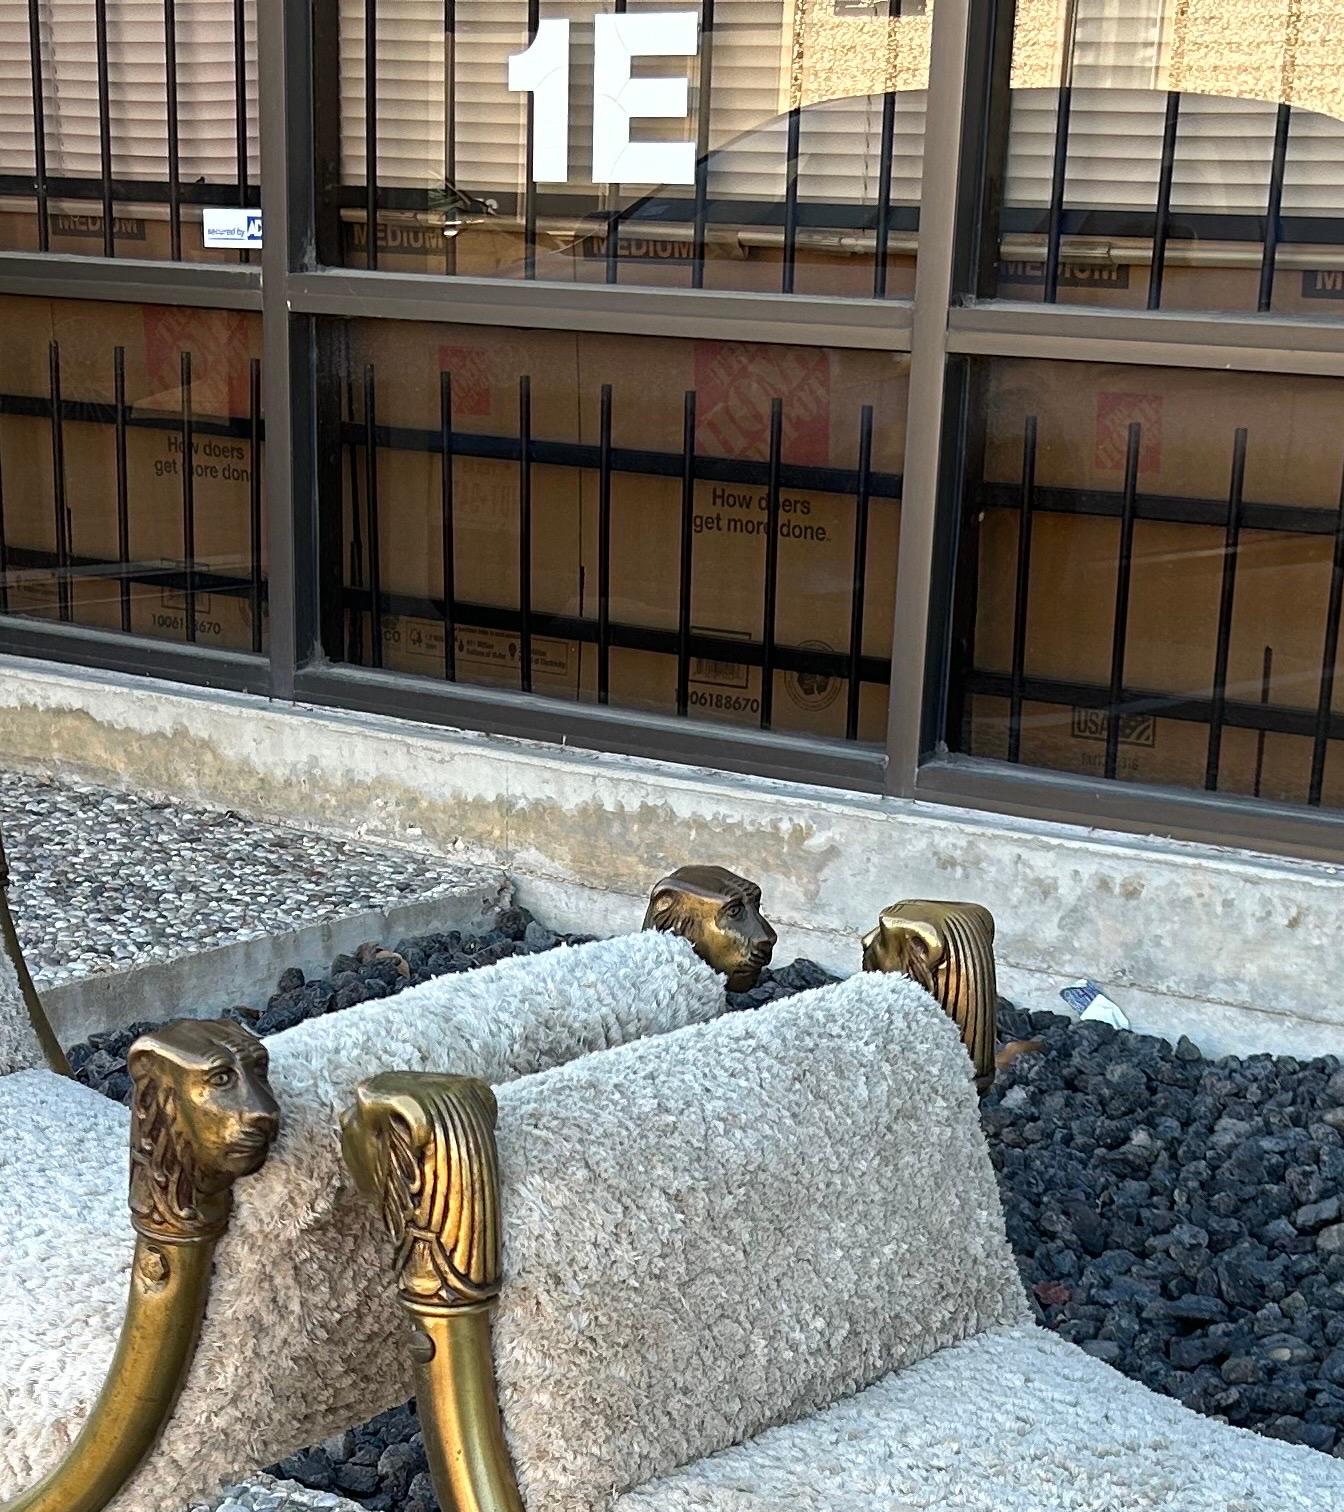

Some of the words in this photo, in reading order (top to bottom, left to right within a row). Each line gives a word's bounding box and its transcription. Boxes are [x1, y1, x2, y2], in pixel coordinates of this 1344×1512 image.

[507, 12, 699, 184] 1E
[1001, 262, 1117, 280] MEIUM
[203, 440, 245, 460] doers
[154, 459, 178, 476] get
[181, 464, 219, 479] ore
[222, 463, 251, 483] don
[711, 487, 753, 509] How
[758, 491, 811, 515] ders
[693, 513, 723, 533] get
[152, 613, 222, 635] 10061670
[674, 687, 761, 714] 106188670
